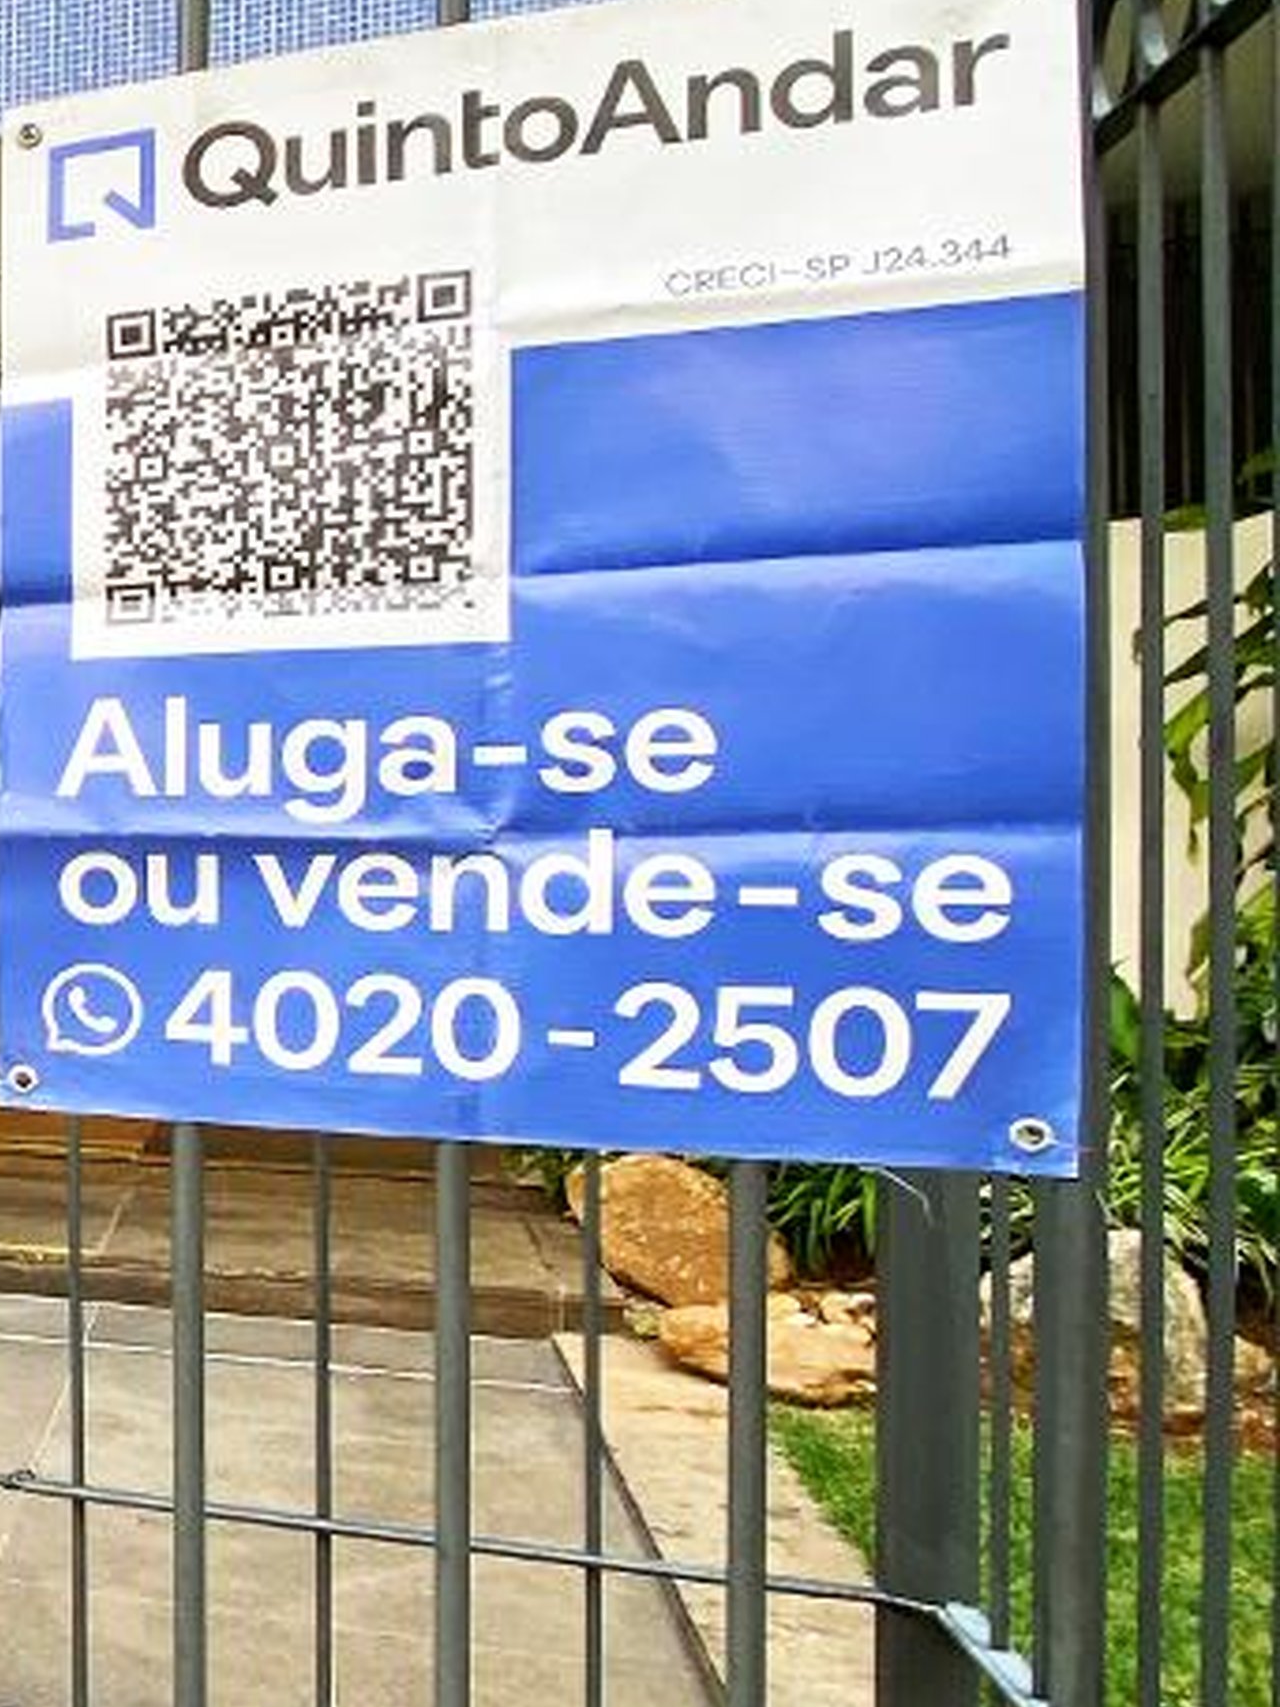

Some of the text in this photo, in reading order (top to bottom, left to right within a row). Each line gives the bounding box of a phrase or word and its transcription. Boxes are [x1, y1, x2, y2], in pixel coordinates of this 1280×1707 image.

[181, 29, 1012, 209] QuintoAndar
[664, 233, 1012, 297] CRECI-SP J24.344
[55, 694, 719, 824] Aluga-se
[57, 828, 1015, 944] ou vende-se
